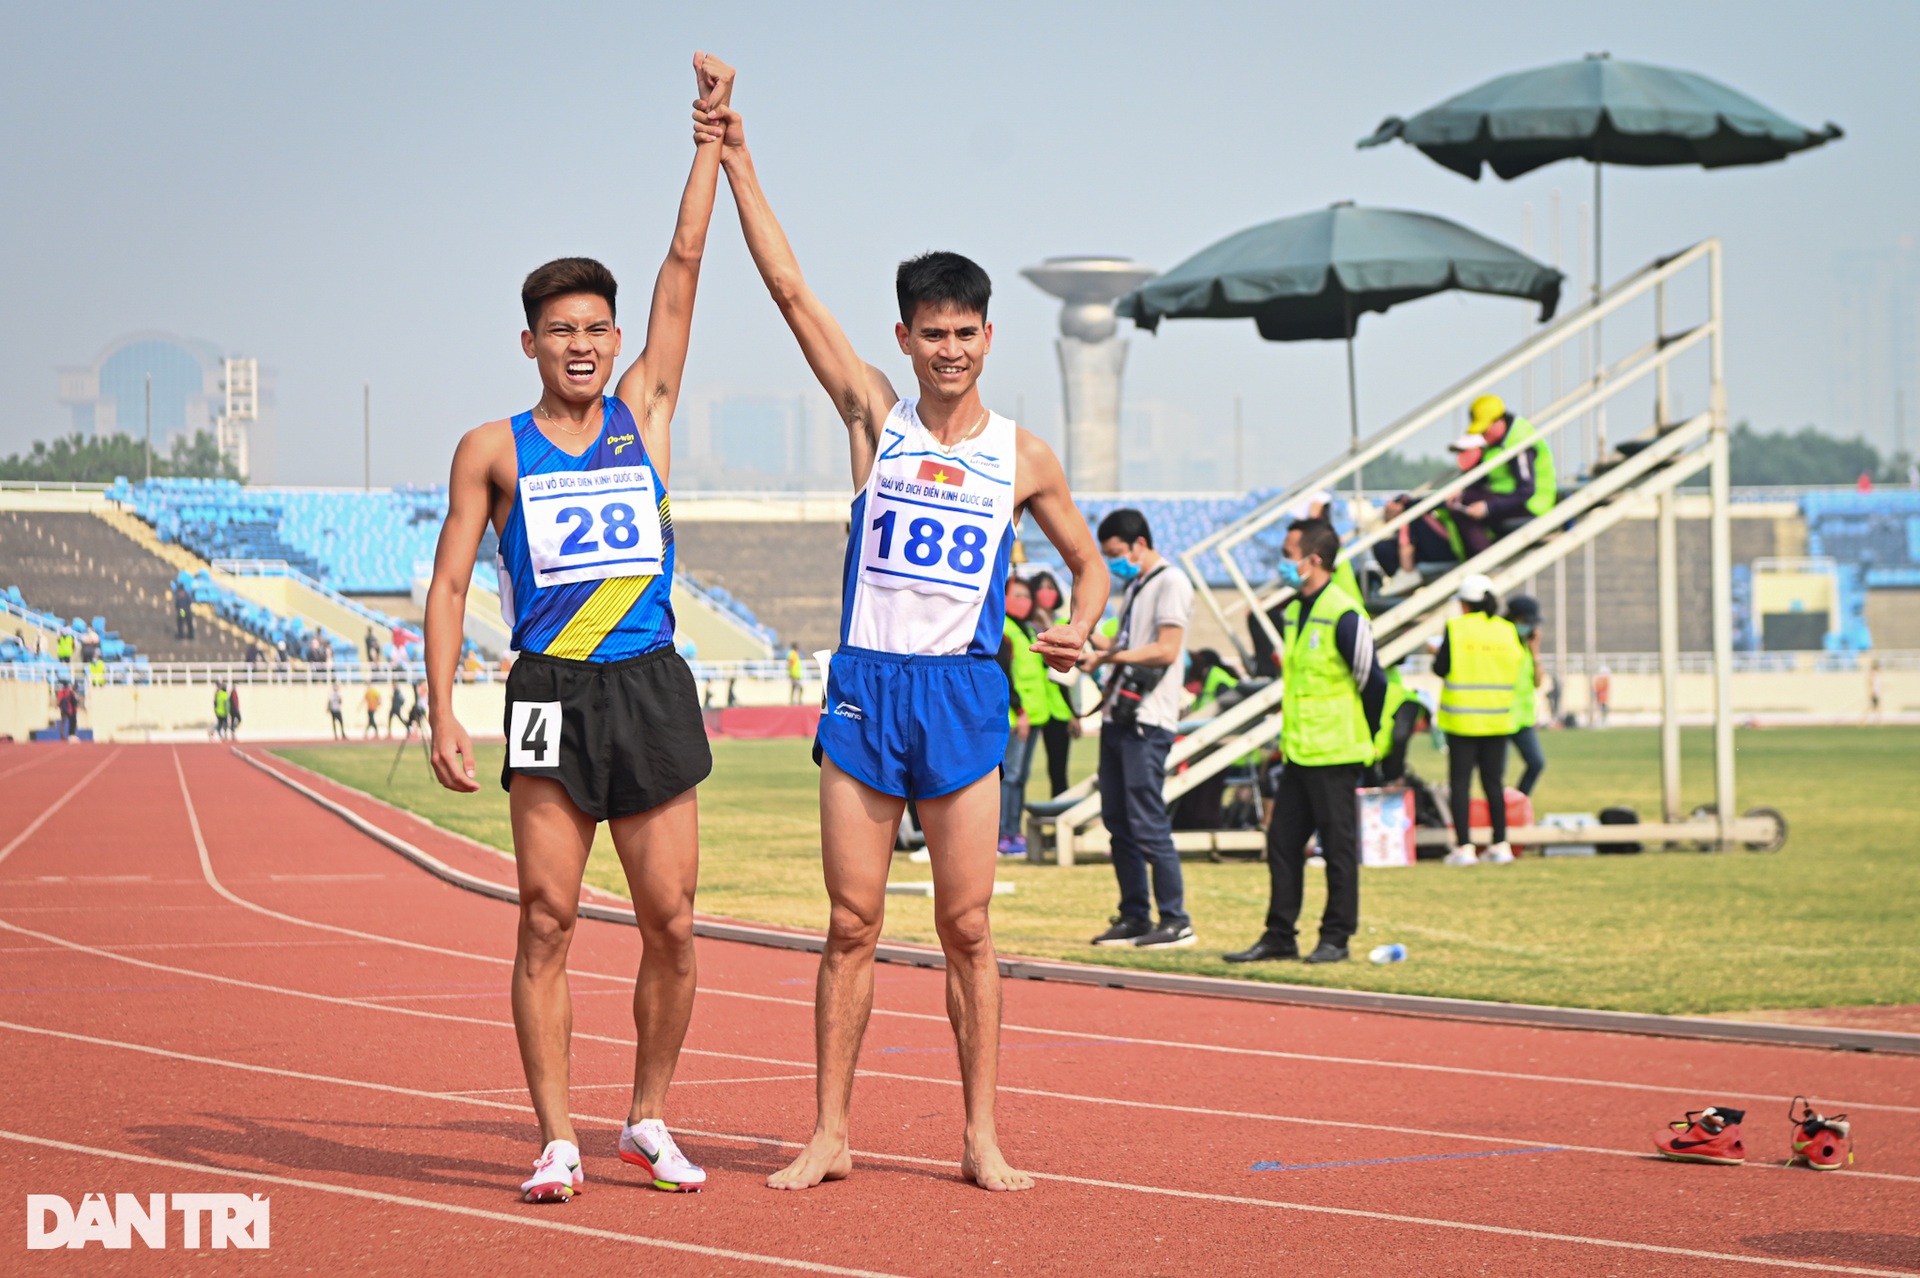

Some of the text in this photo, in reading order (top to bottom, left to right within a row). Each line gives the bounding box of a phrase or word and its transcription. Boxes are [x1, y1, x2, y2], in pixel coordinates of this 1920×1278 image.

[594, 474, 612, 485] KINH
[634, 472, 645, 482] GIA
[940, 489, 959, 502] KINH
[982, 497, 994, 508] GIA
[555, 502, 640, 557] 28
[872, 510, 988, 575] 188
[521, 708, 548, 761] 4
